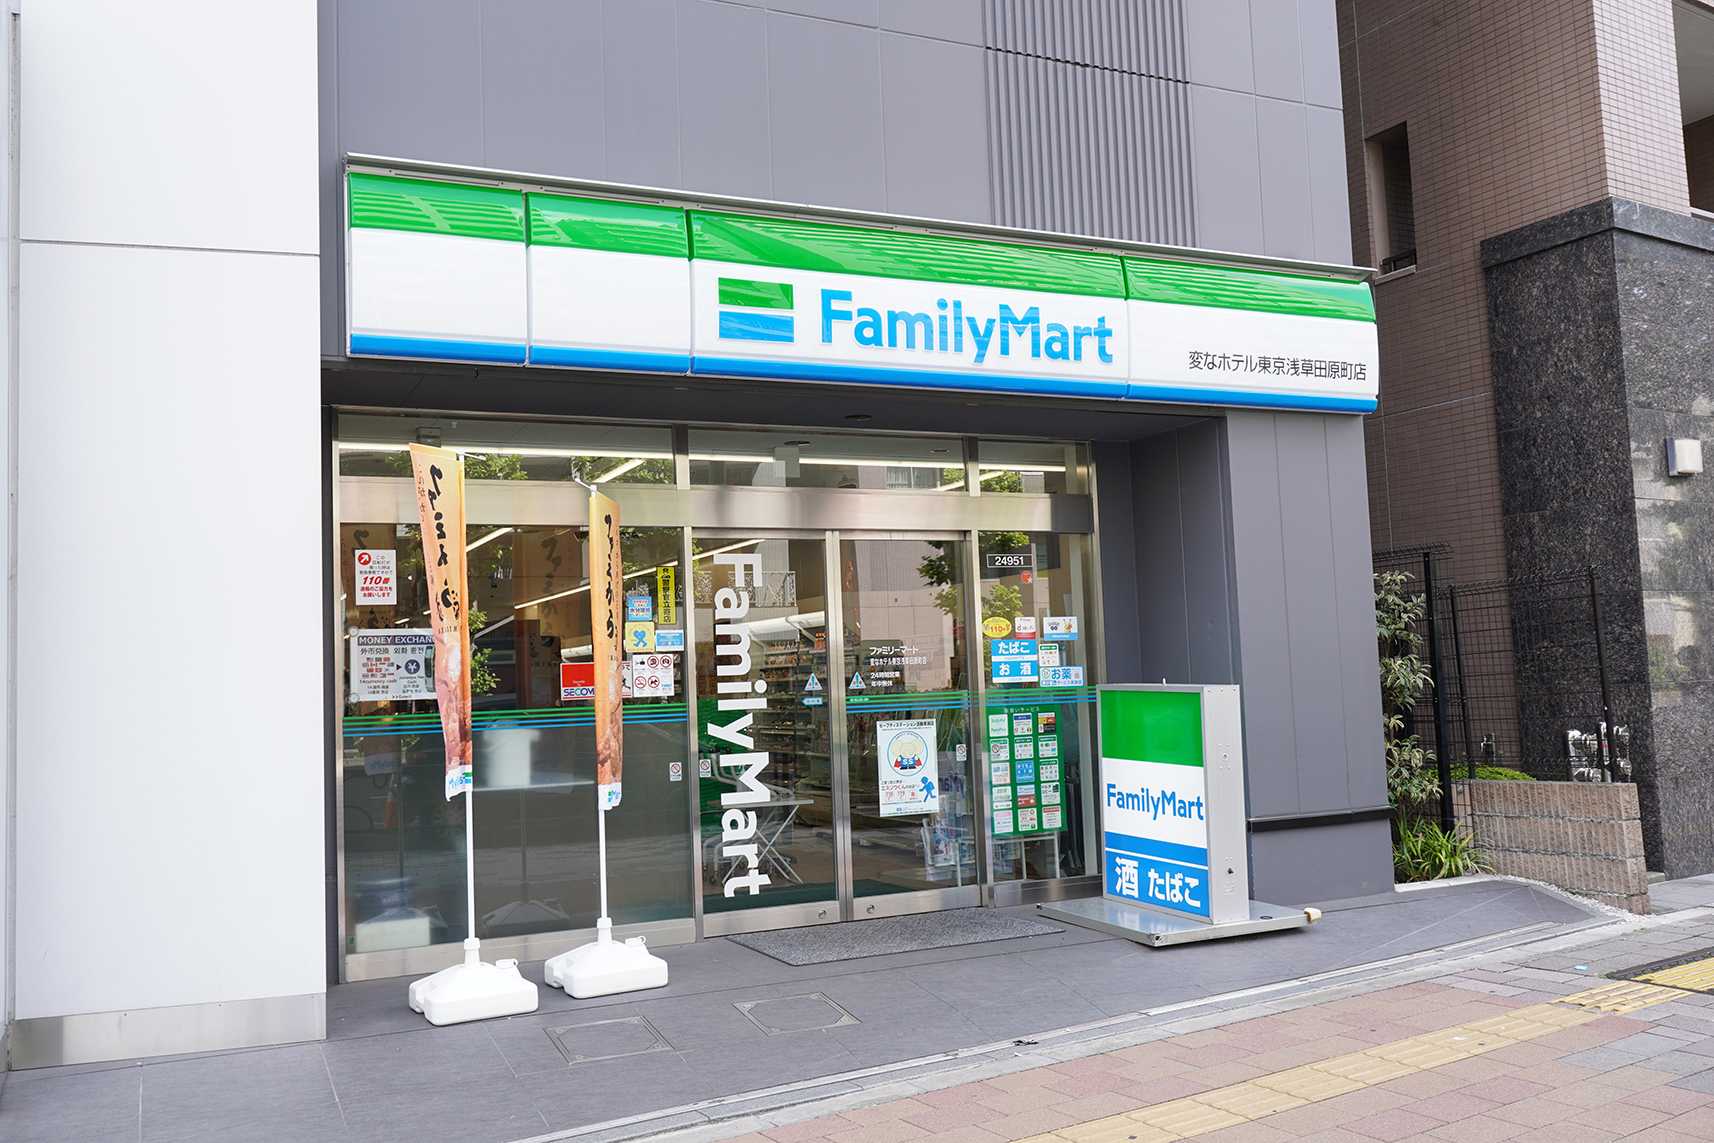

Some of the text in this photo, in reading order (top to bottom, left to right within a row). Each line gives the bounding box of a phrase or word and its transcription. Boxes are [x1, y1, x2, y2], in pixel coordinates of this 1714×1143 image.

[820, 288, 1113, 363] FamilyMart
[1188, 350, 1367, 381] 変なホテル東京浅草田原町店
[995, 556, 1024, 566] 24951
[359, 636, 433, 645] MONEY EXCHAN
[869, 645, 920, 656] ファミリーマート
[998, 641, 1030, 655] たばこ
[563, 687, 595, 697] SECOM
[707, 552, 772, 898] FamilyMart
[1106, 783, 1204, 821] FamilyMart
[1114, 856, 1201, 908] 酒 たばこ
